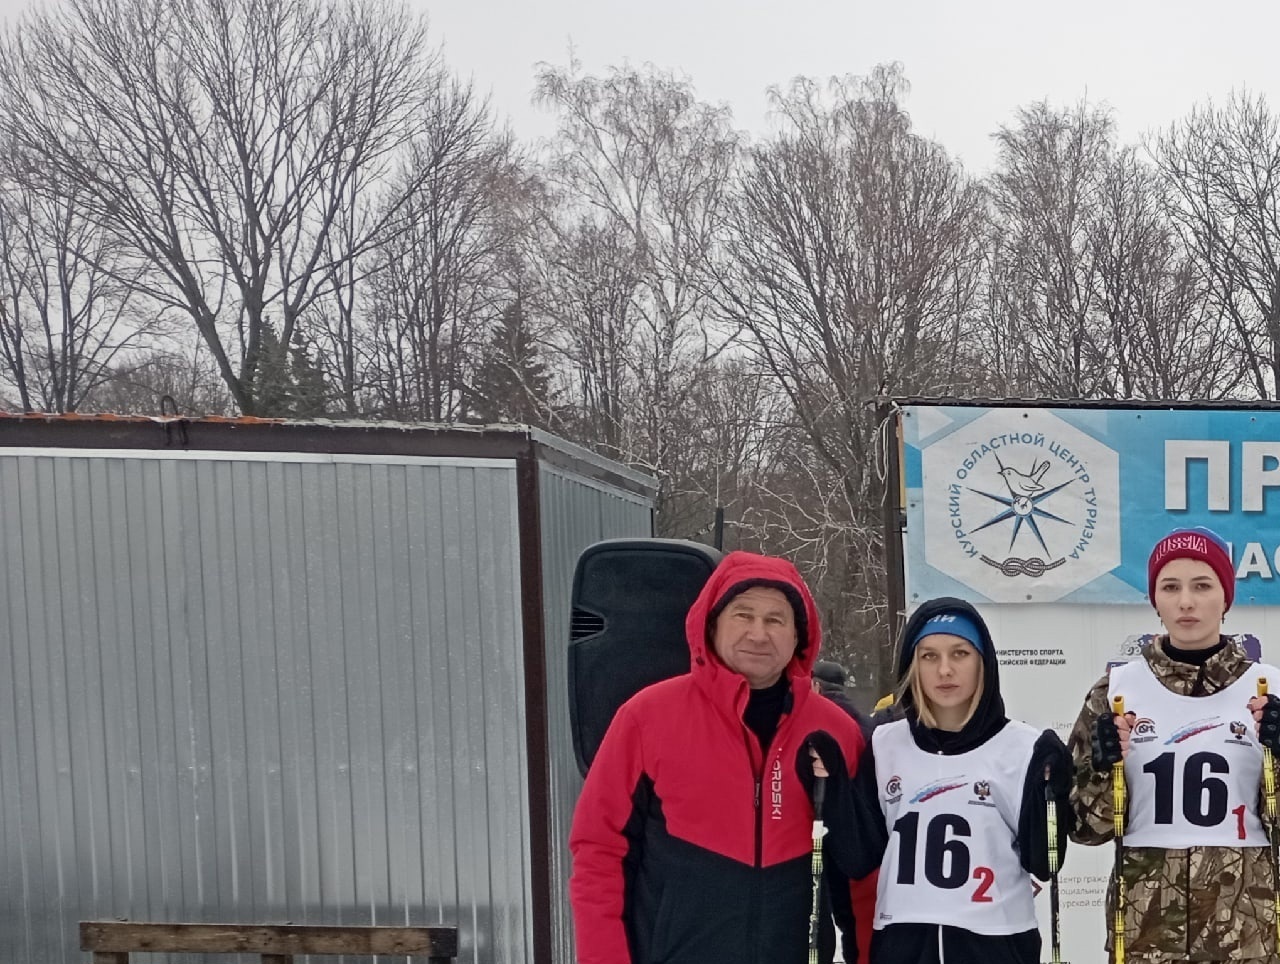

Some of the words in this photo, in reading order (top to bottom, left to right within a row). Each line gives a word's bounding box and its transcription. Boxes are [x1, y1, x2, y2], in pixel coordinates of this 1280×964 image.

[957, 432, 1045, 480] ОБЛАСТНОЙ
[1049, 440, 1090, 483] ЦЕНТР
[949, 483, 979, 558] КУРСКИЙ
[1069, 488, 1097, 560] ТУРИЗМА
[1143, 751, 1230, 827] 16
[893, 811, 971, 889] 16
[1232, 804, 1247, 840] 1
[971, 866, 995, 902] 2
